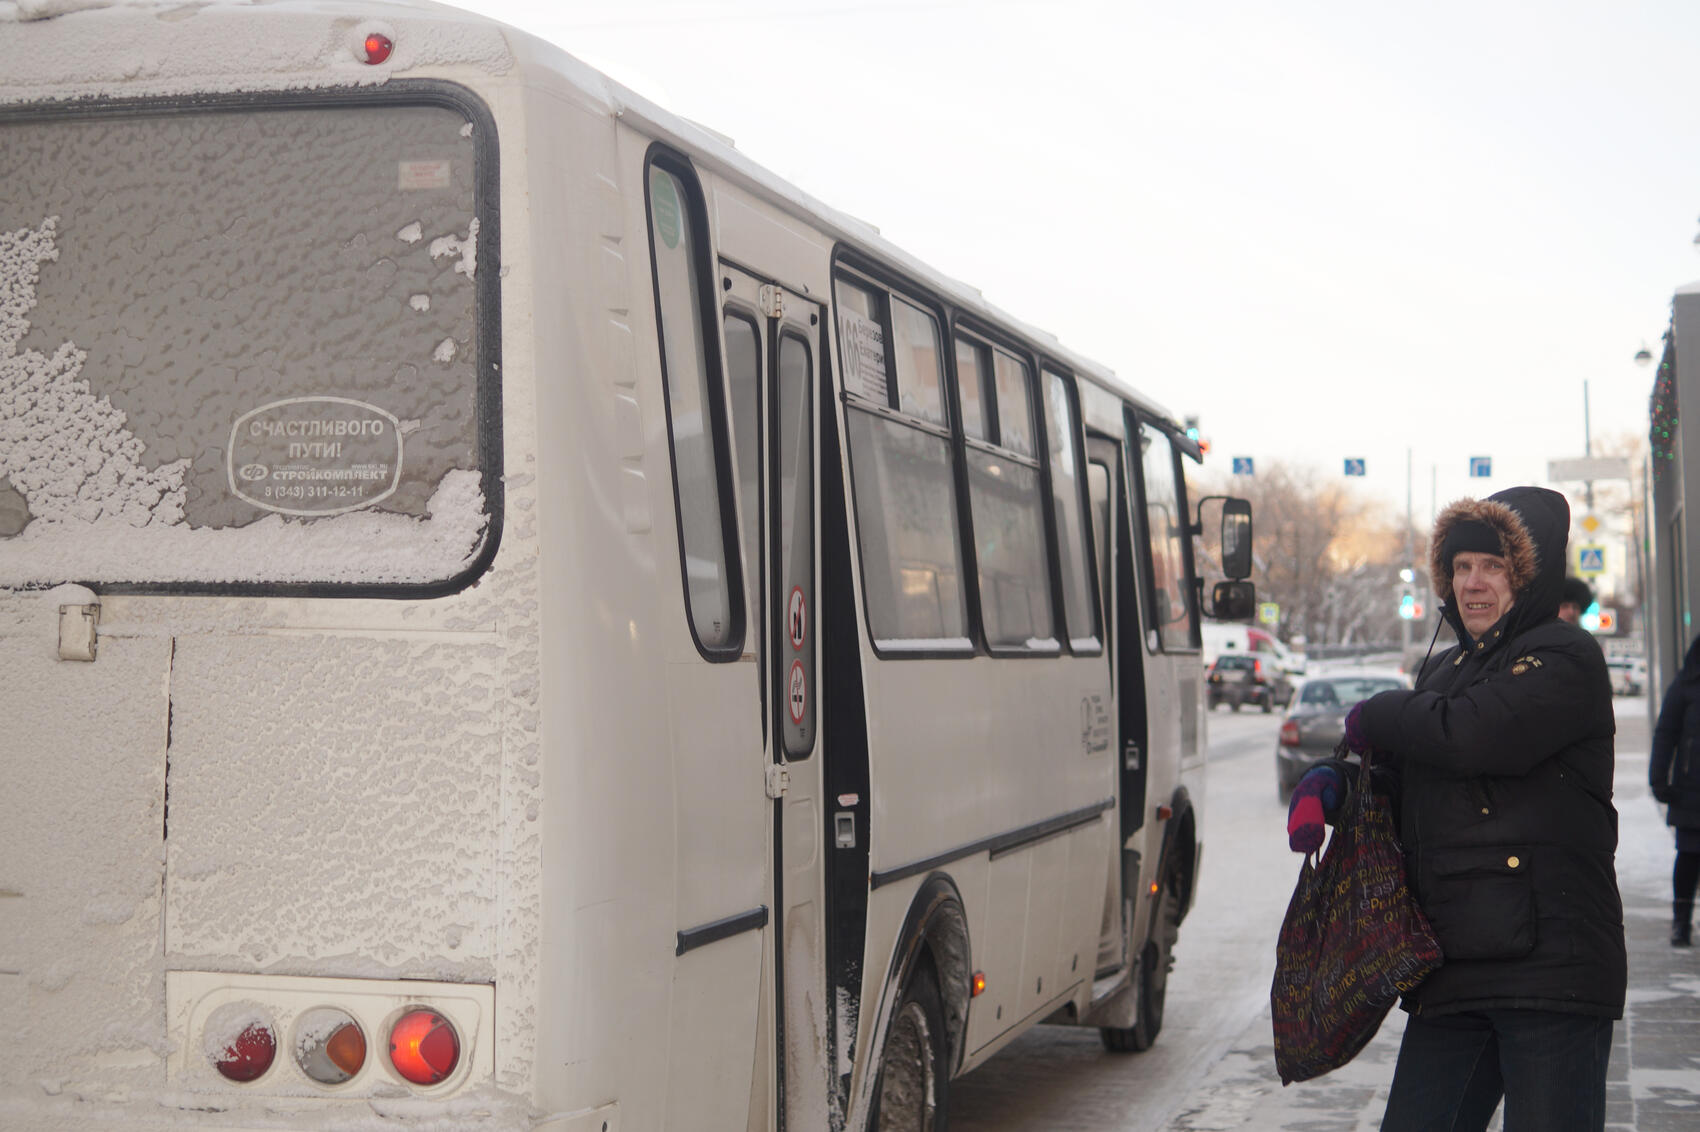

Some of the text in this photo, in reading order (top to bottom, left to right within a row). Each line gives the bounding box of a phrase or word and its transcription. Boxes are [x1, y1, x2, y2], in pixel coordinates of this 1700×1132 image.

[250, 419, 384, 436] СЧАСТЛИВОГО
[289, 442, 342, 458] ПУТИ!
[272, 468, 388, 480] СТРОЙКОМПЛЕКТ
[264, 486, 363, 499] 8 (343) 311-12-11
